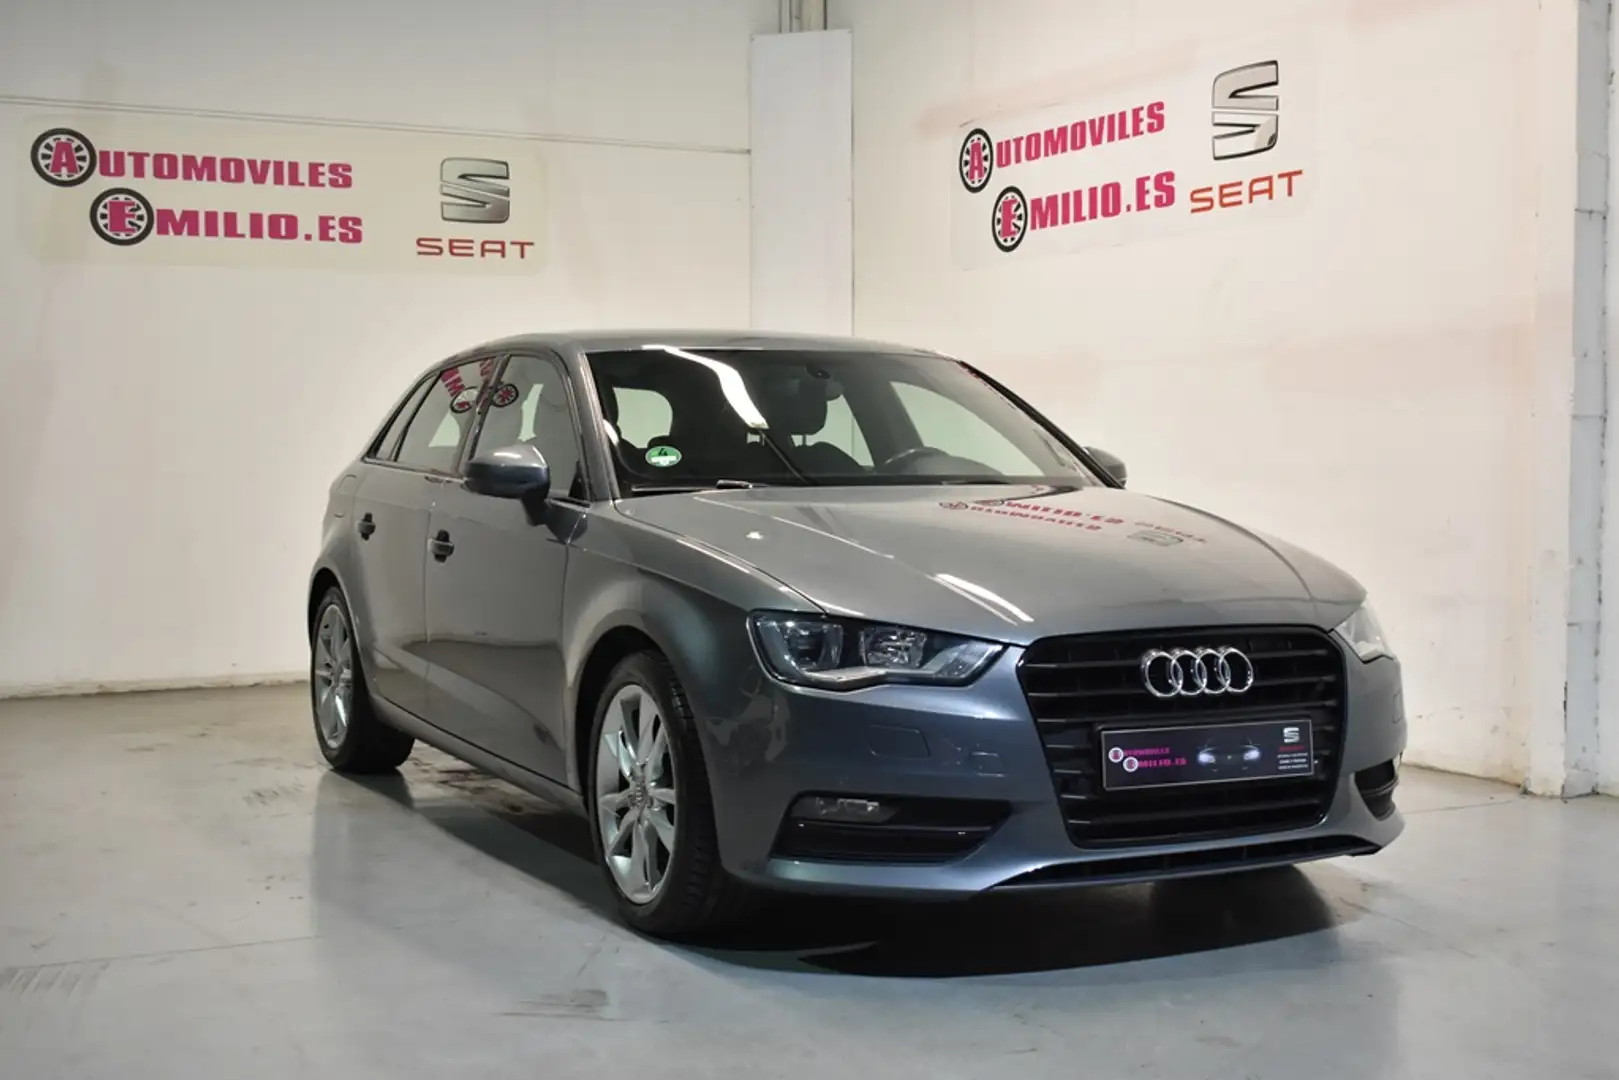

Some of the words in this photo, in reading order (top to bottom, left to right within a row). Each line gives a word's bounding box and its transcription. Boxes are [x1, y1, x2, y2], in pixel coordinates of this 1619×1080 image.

[968, 100, 1166, 181] AUTOMOVILES
[50, 142, 353, 189] AUTOMOVILES
[1000, 170, 1176, 239] EMILIO.ES
[1189, 169, 1304, 214] SEAT
[108, 200, 363, 243] EMILIO.ES
[415, 237, 535, 259] SEAT
